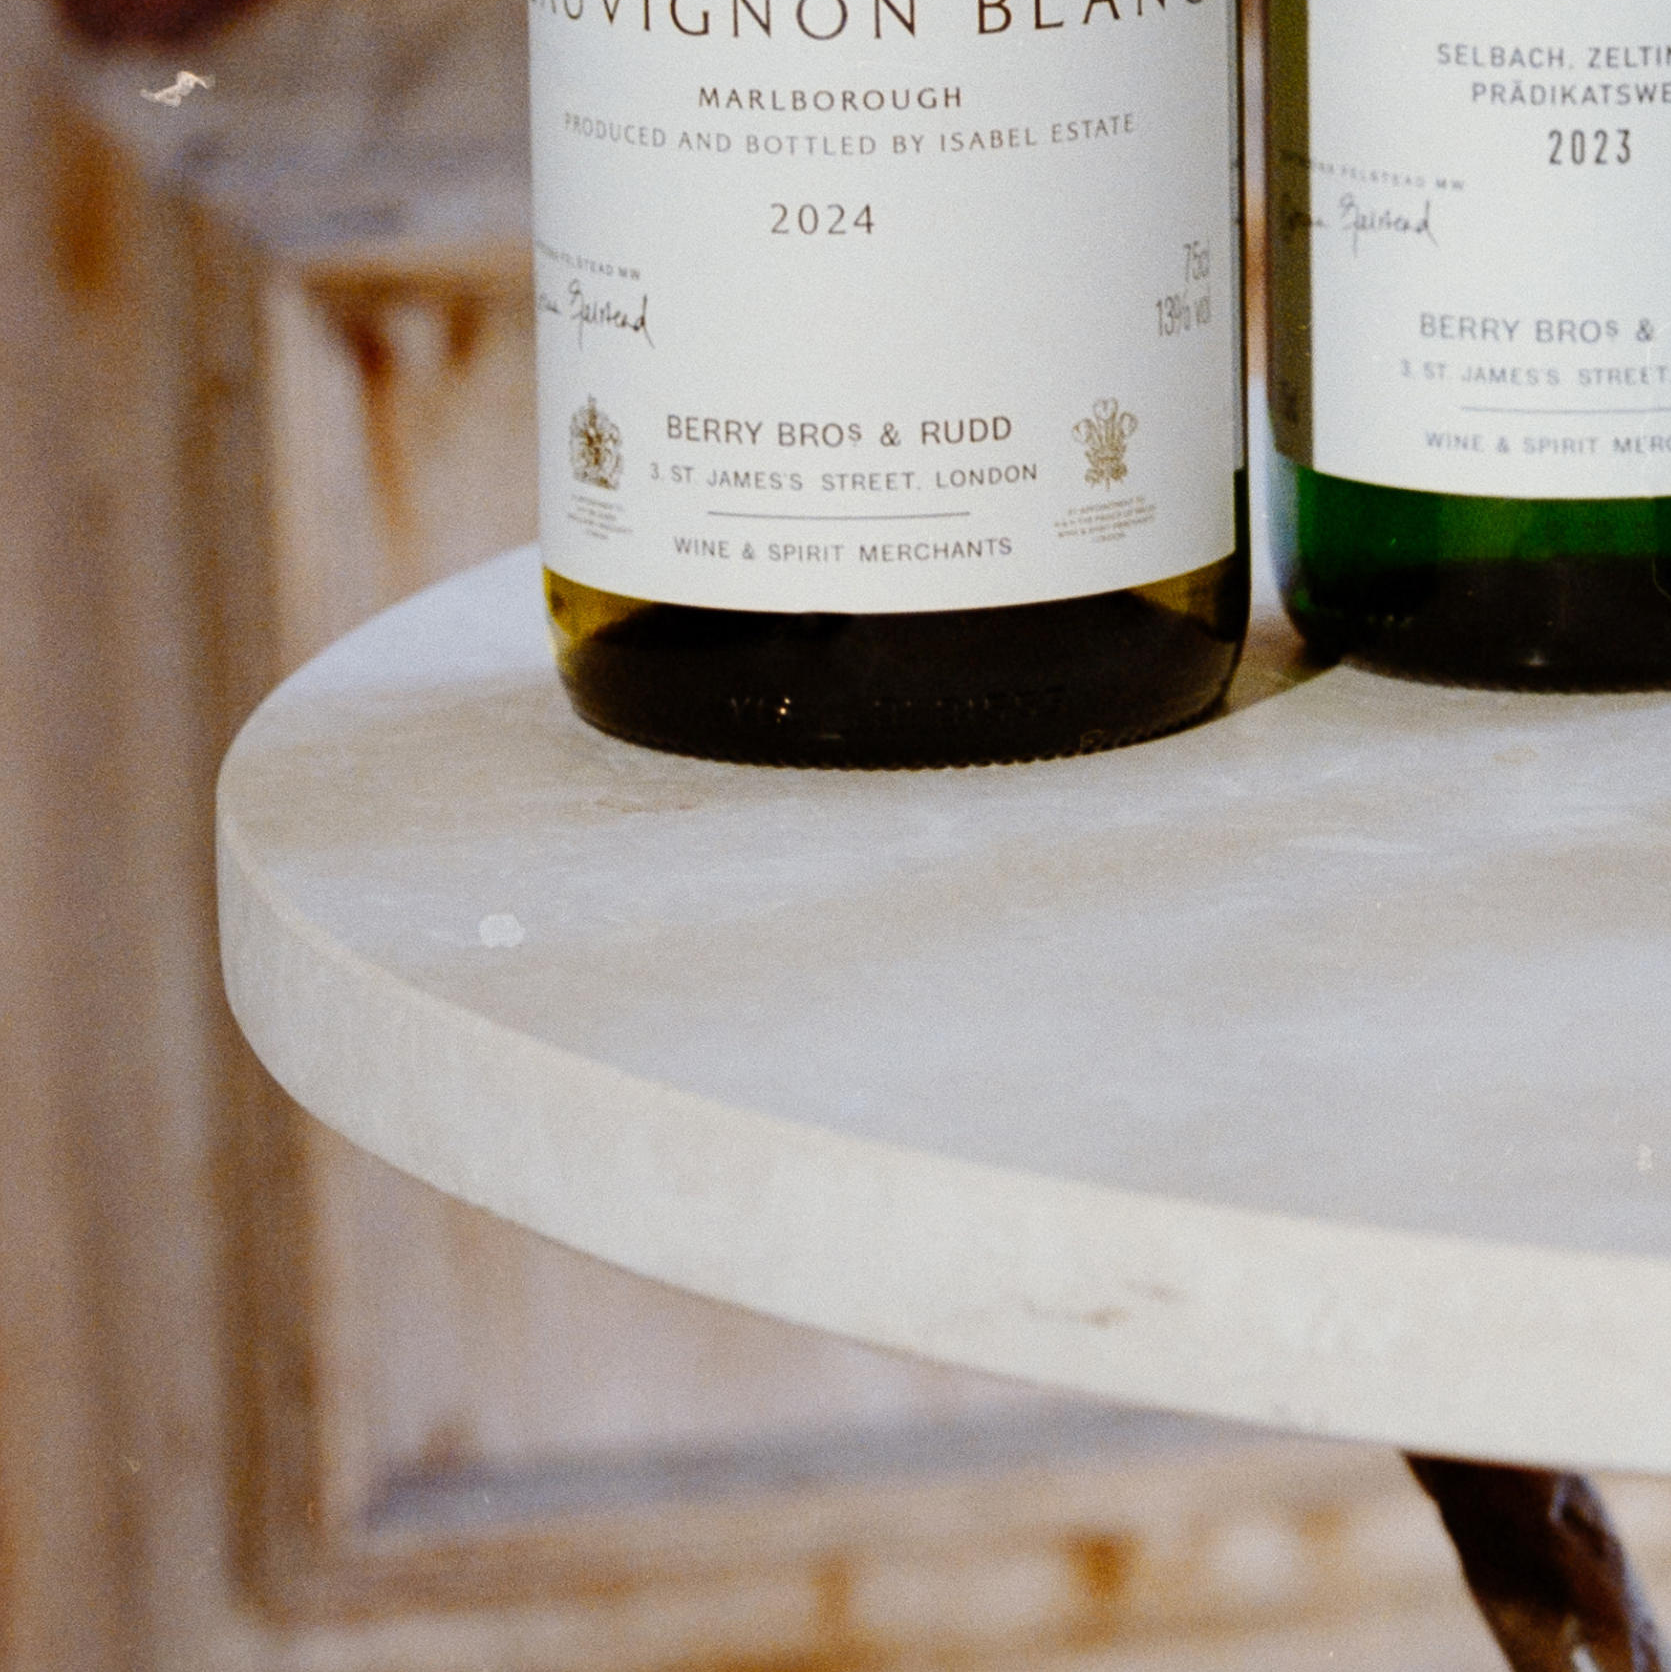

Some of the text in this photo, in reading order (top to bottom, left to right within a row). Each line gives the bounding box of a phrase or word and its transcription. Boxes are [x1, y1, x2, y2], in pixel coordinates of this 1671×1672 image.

[698, 85, 962, 113] MARLBOROUGH
[563, 111, 1134, 157] PRODUCED AND BOTTLED BY ISABEL ESTATE
[1547, 127, 1632, 167] 2023
[770, 202, 876, 236] 2024
[1419, 311, 1521, 343] BERRY
[1634, 317, 1655, 344] &
[1460, 365, 1561, 387] JAMES'S
[666, 413, 764, 446] BERRY
[878, 421, 902, 448] &
[920, 414, 1013, 446] RUDD
[1424, 431, 1484, 453] WINE
[1495, 435, 1511, 455] &
[1522, 435, 1599, 456] SPIRIT
[705, 469, 804, 492] JAMES'S
[934, 462, 1038, 490] LONDON
[673, 536, 1013, 564] WINE & SPIRIT MERCHANTS
